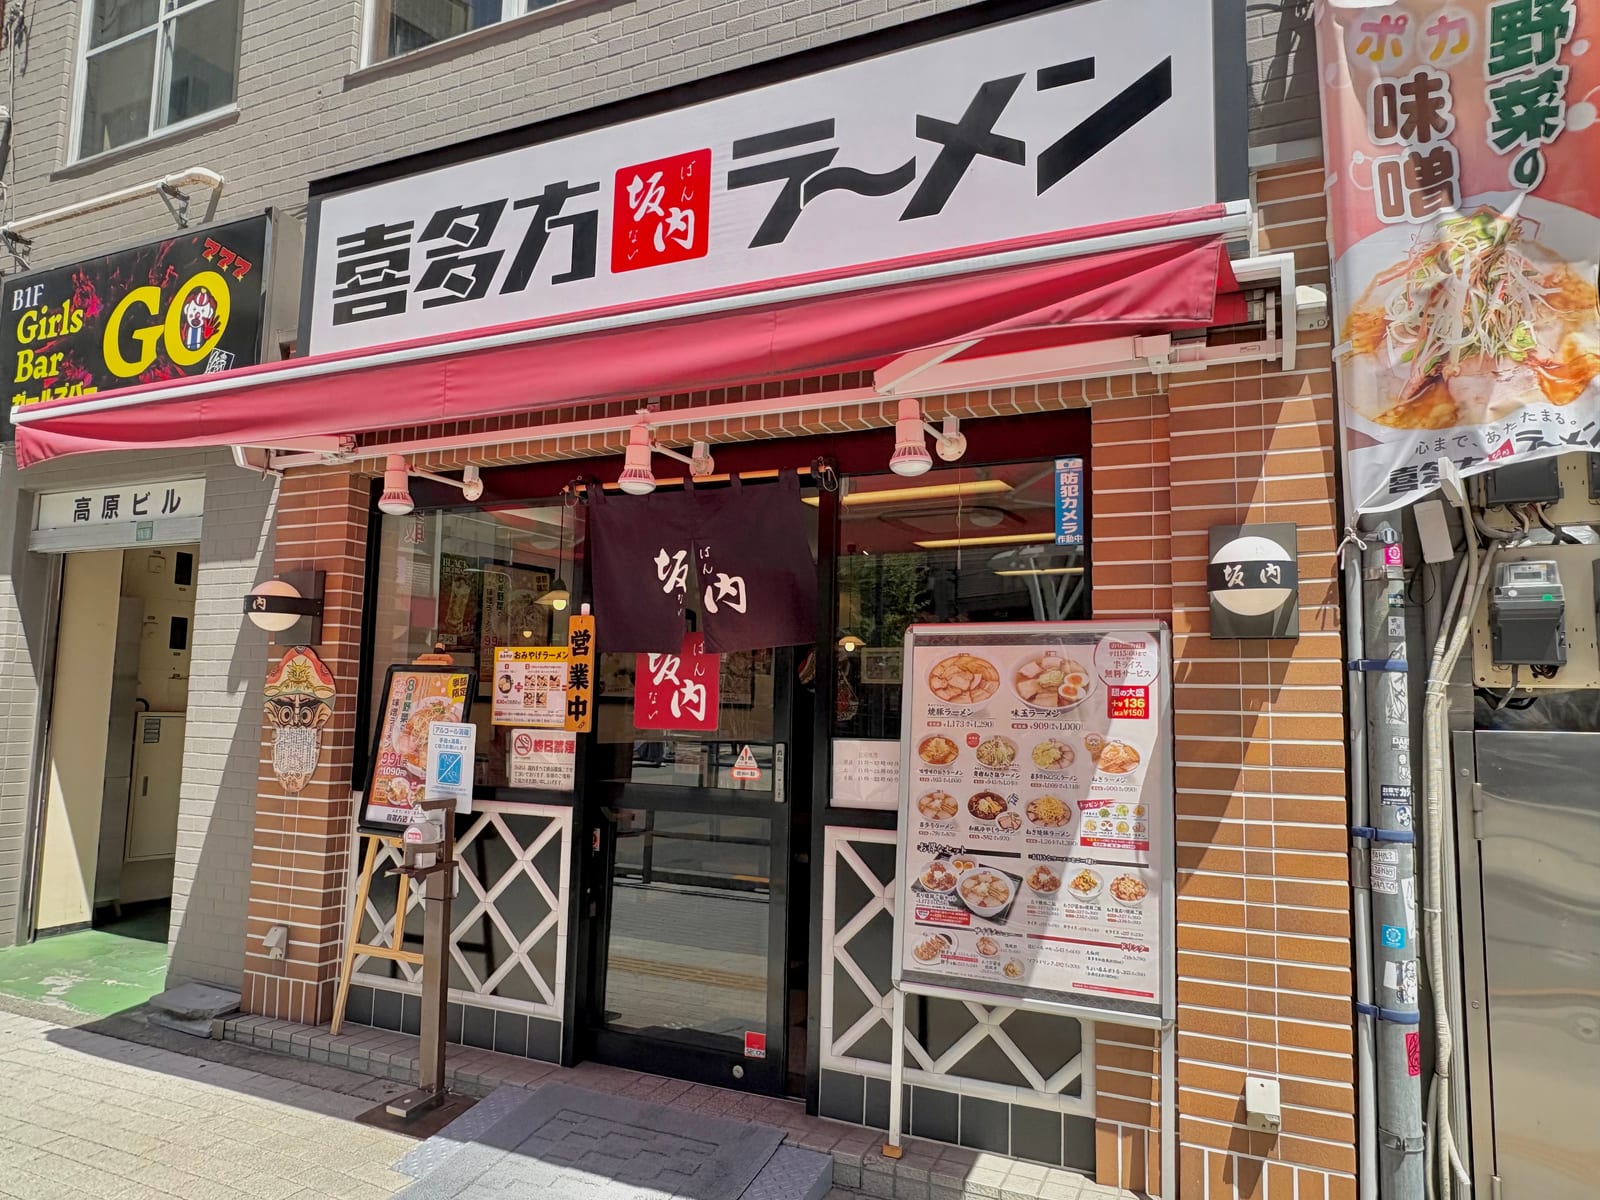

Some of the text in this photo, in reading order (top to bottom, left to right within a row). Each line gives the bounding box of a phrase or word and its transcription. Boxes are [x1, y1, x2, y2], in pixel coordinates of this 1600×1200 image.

[727, 54, 1173, 249] ラーメン
[1373, 71, 1454, 219] 味噌
[626, 171, 695, 252] 坂内
[203, 237, 252, 281] 777
[332, 180, 599, 326] 喜多方
[12, 284, 44, 311] B1F
[16, 301, 84, 344] Girls
[103, 271, 231, 378] GO
[14, 348, 63, 383] Bar
[73, 488, 181, 522] 高原ビル
[1060, 472, 1079, 534] 防犯カメラ
[1058, 535, 1082, 543] 作動中
[654, 548, 748, 614] 坂内
[1223, 563, 1281, 588] 坂内
[252, 597, 266, 611] 内
[514, 651, 568, 660] おみやげラーメン
[567, 629, 592, 722] 営業中
[928, 707, 974, 717] 焼豚ラーメン
[1011, 710, 1060, 718] 味玉ラーメン
